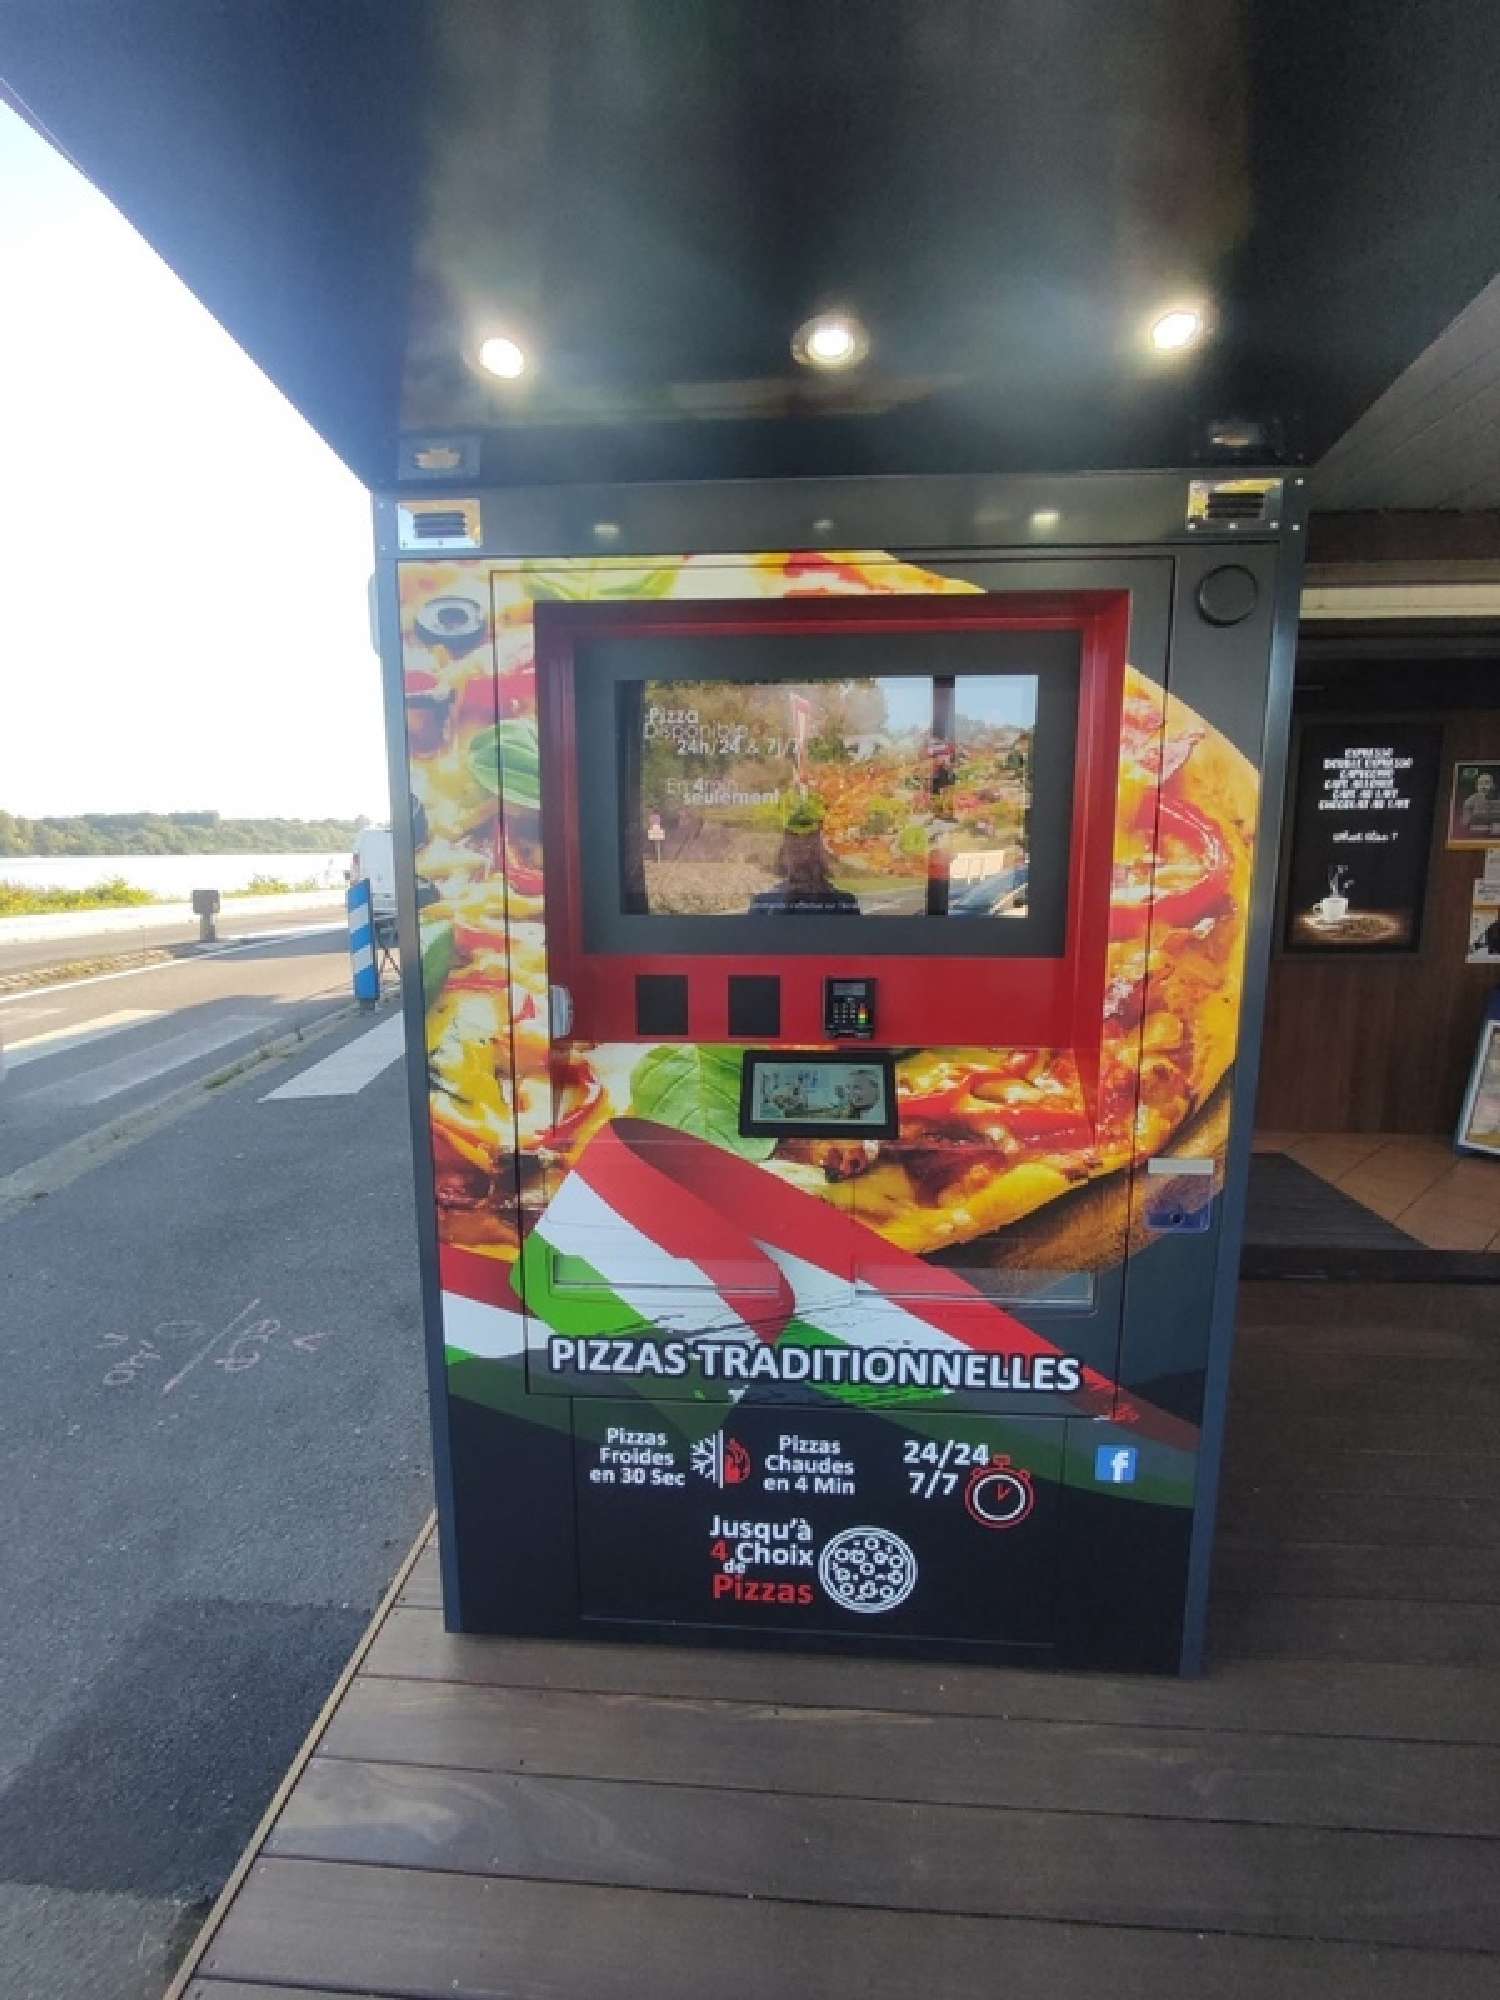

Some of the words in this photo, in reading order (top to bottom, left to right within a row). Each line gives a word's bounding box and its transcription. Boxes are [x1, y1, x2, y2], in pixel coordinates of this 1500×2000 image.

[551, 1338, 687, 1376] PIZZAS
[697, 1344, 1081, 1391] TRADITIONNELLES
[607, 1428, 668, 1446] Pizzas
[779, 1435, 841, 1454] Pizzas
[600, 1447, 674, 1465] Froides
[764, 1454, 856, 1475] Chaudes
[903, 1439, 990, 1469] 24/24
[589, 1468, 616, 1484] en
[620, 1467, 646, 1484] 30
[650, 1468, 686, 1487] Sec
[763, 1476, 789, 1492] en
[794, 1474, 808, 1493] 4
[814, 1476, 856, 1495] Min
[908, 1469, 959, 1499] 7/7
[709, 1514, 814, 1545] Jusqu'à
[710, 1539, 728, 1561] 4
[735, 1539, 814, 1566] Choix
[722, 1557, 746, 1574] de
[712, 1574, 814, 1604] Pizzas
